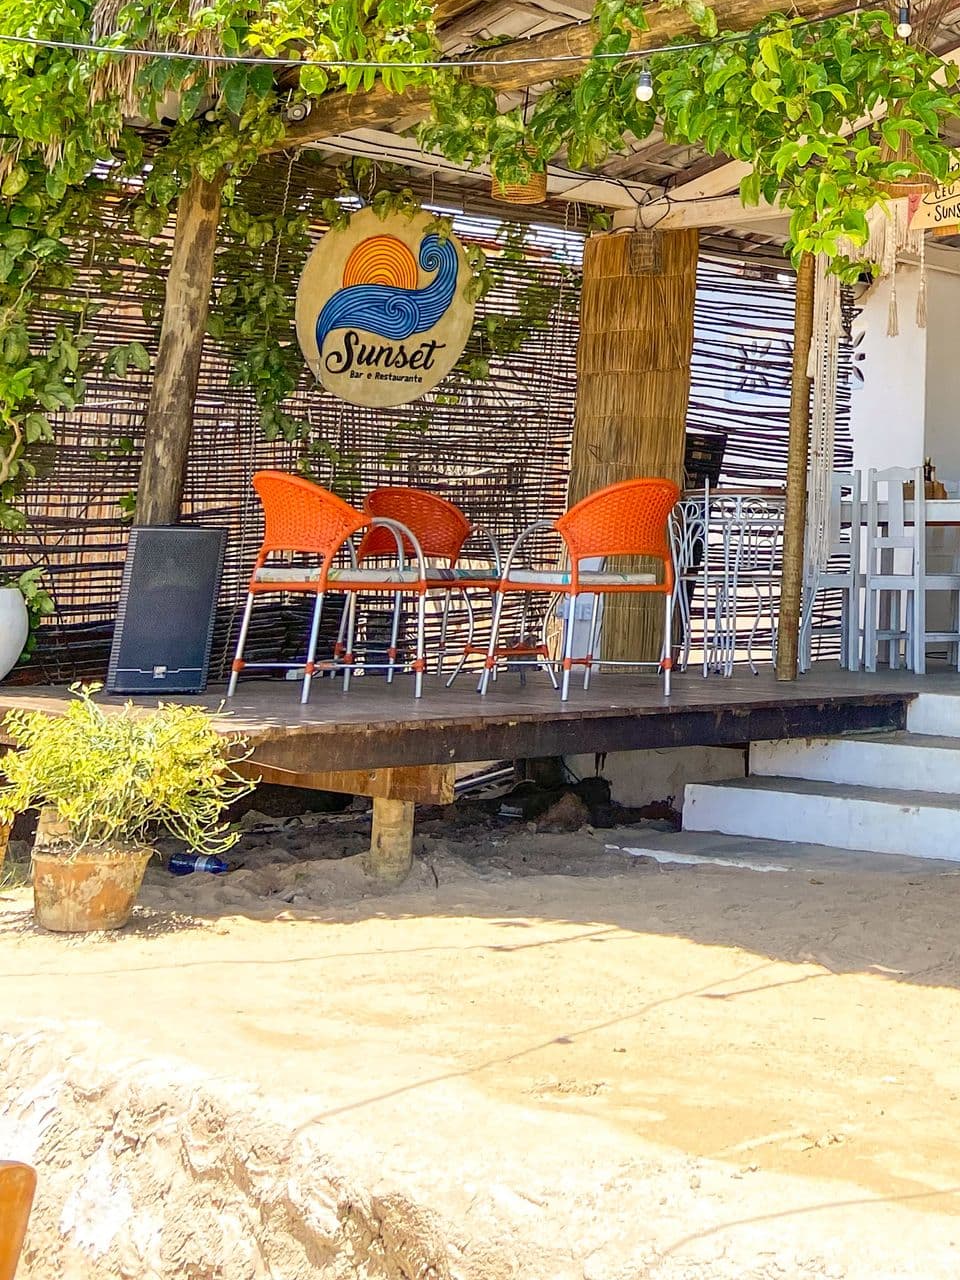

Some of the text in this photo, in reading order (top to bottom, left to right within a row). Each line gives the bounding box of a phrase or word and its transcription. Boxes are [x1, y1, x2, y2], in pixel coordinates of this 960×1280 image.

[325, 330, 447, 374] Sunset
[350, 369, 364, 379] Bar
[375, 372, 423, 383] Restaurante
